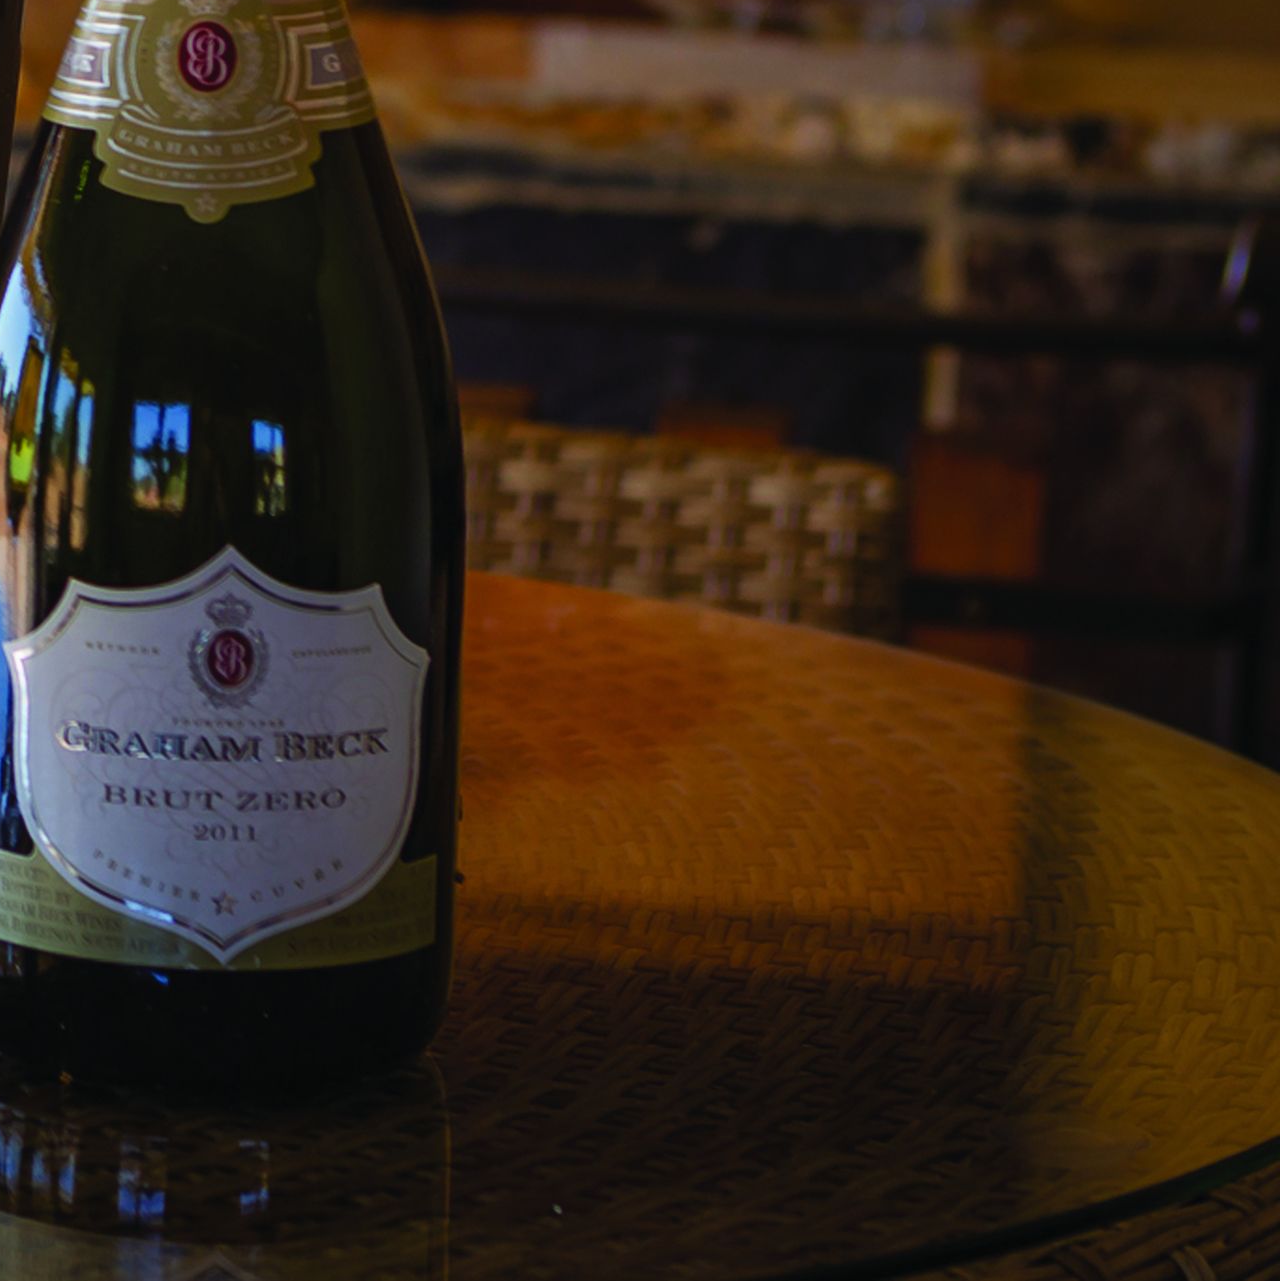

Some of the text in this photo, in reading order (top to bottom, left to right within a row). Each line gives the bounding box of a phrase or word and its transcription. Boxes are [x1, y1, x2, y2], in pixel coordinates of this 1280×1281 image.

[118, 128, 295, 157] GRAHAM BECK
[56, 719, 393, 763] GRAHAM BECK
[103, 783, 347, 813] BRUT ZERO
[192, 823, 258, 843] 2011
[92, 848, 200, 904] PREMIER
